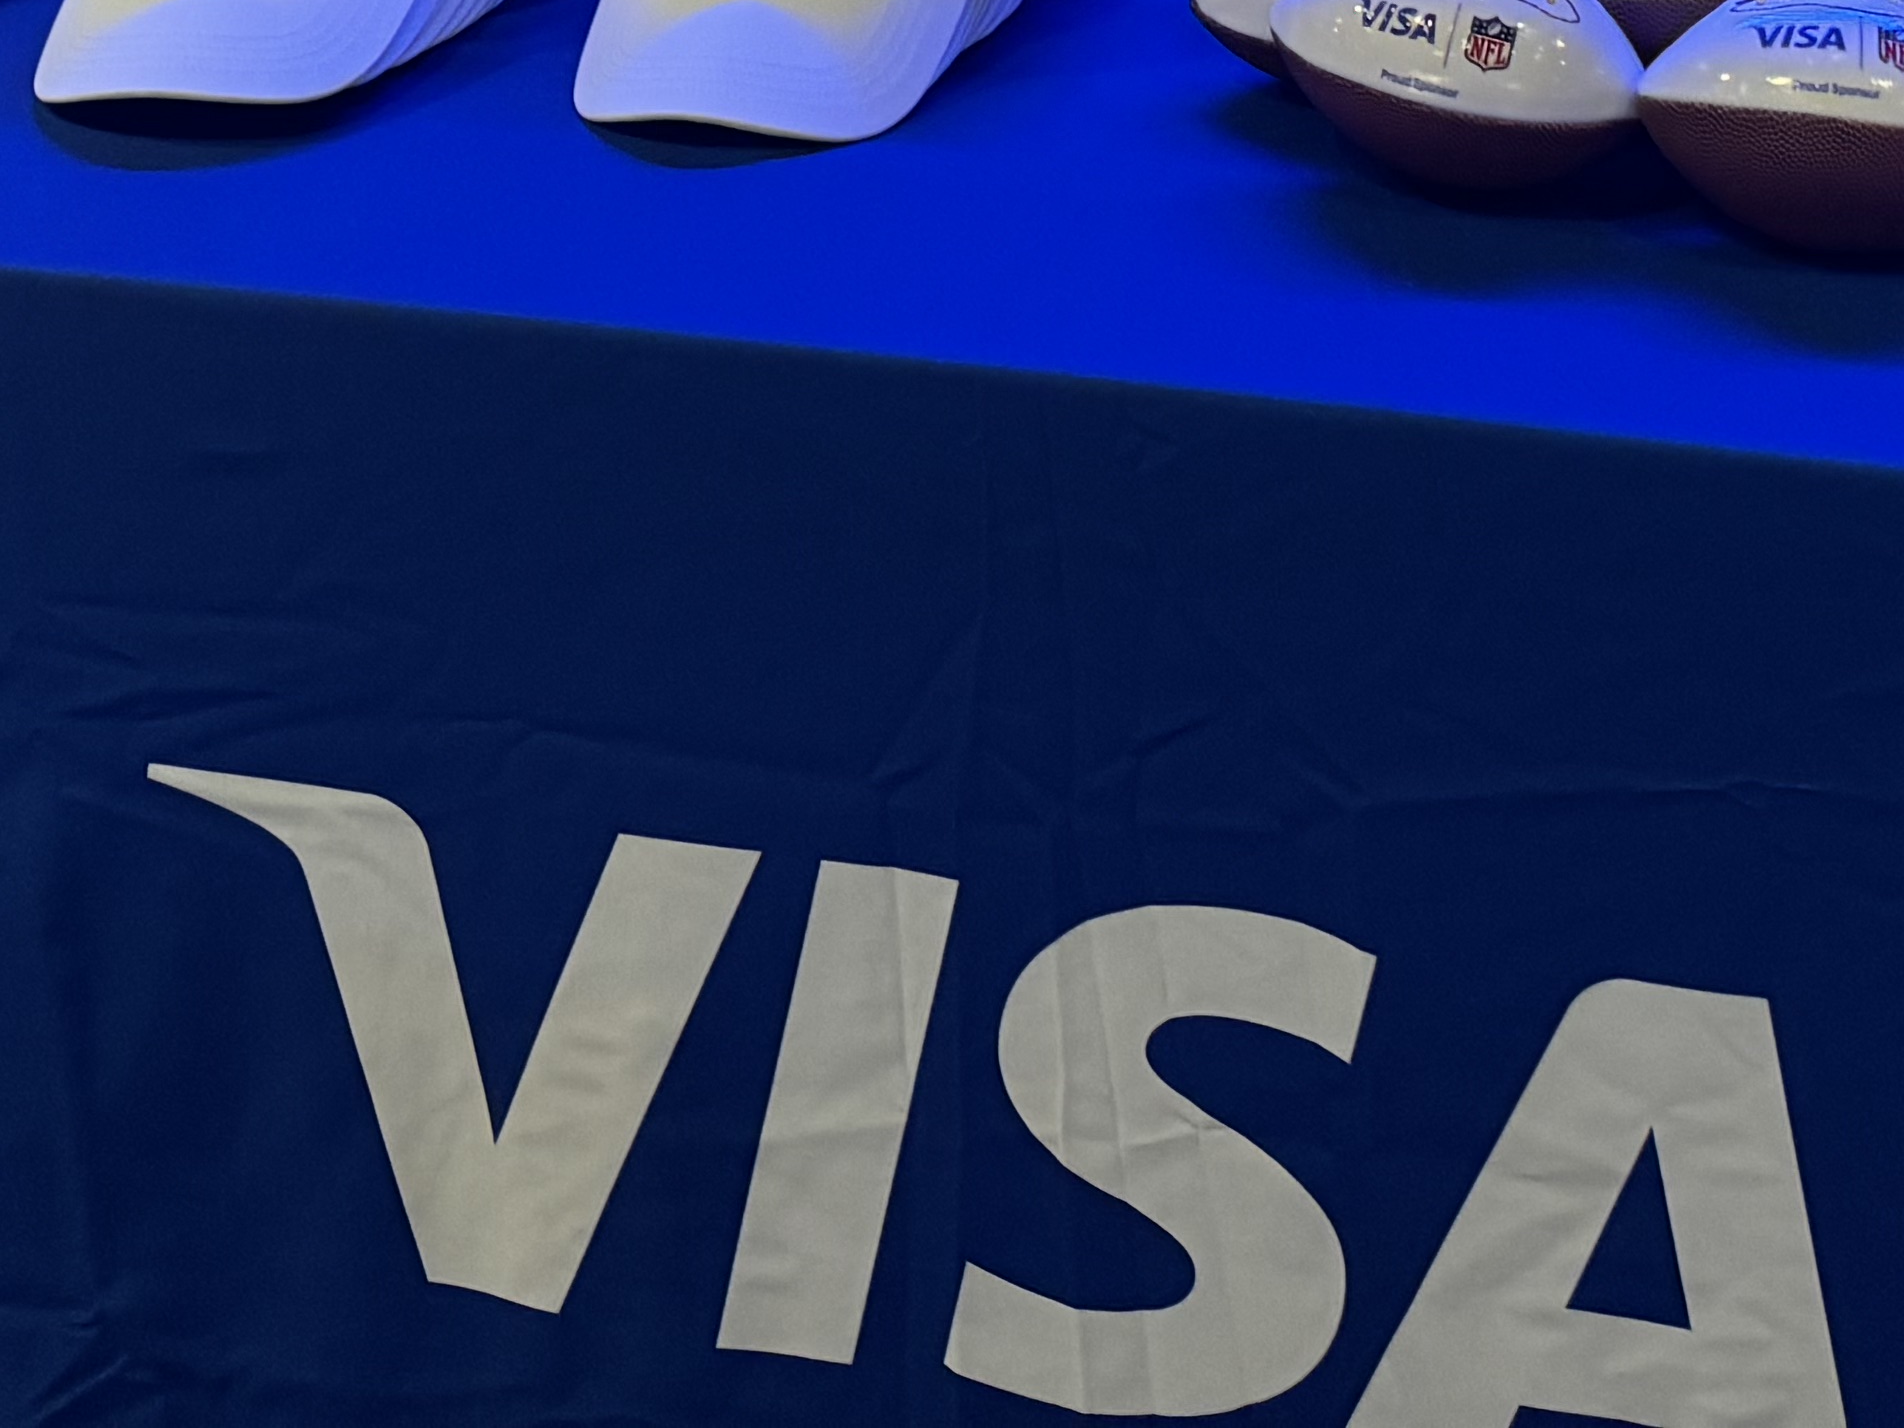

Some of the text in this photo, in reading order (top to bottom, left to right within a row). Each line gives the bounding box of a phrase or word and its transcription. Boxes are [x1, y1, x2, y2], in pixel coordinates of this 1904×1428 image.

[1469, 35, 1508, 66] NFL
[1753, 24, 1846, 51] VISA
[146, 762, 1848, 1428] VISA
